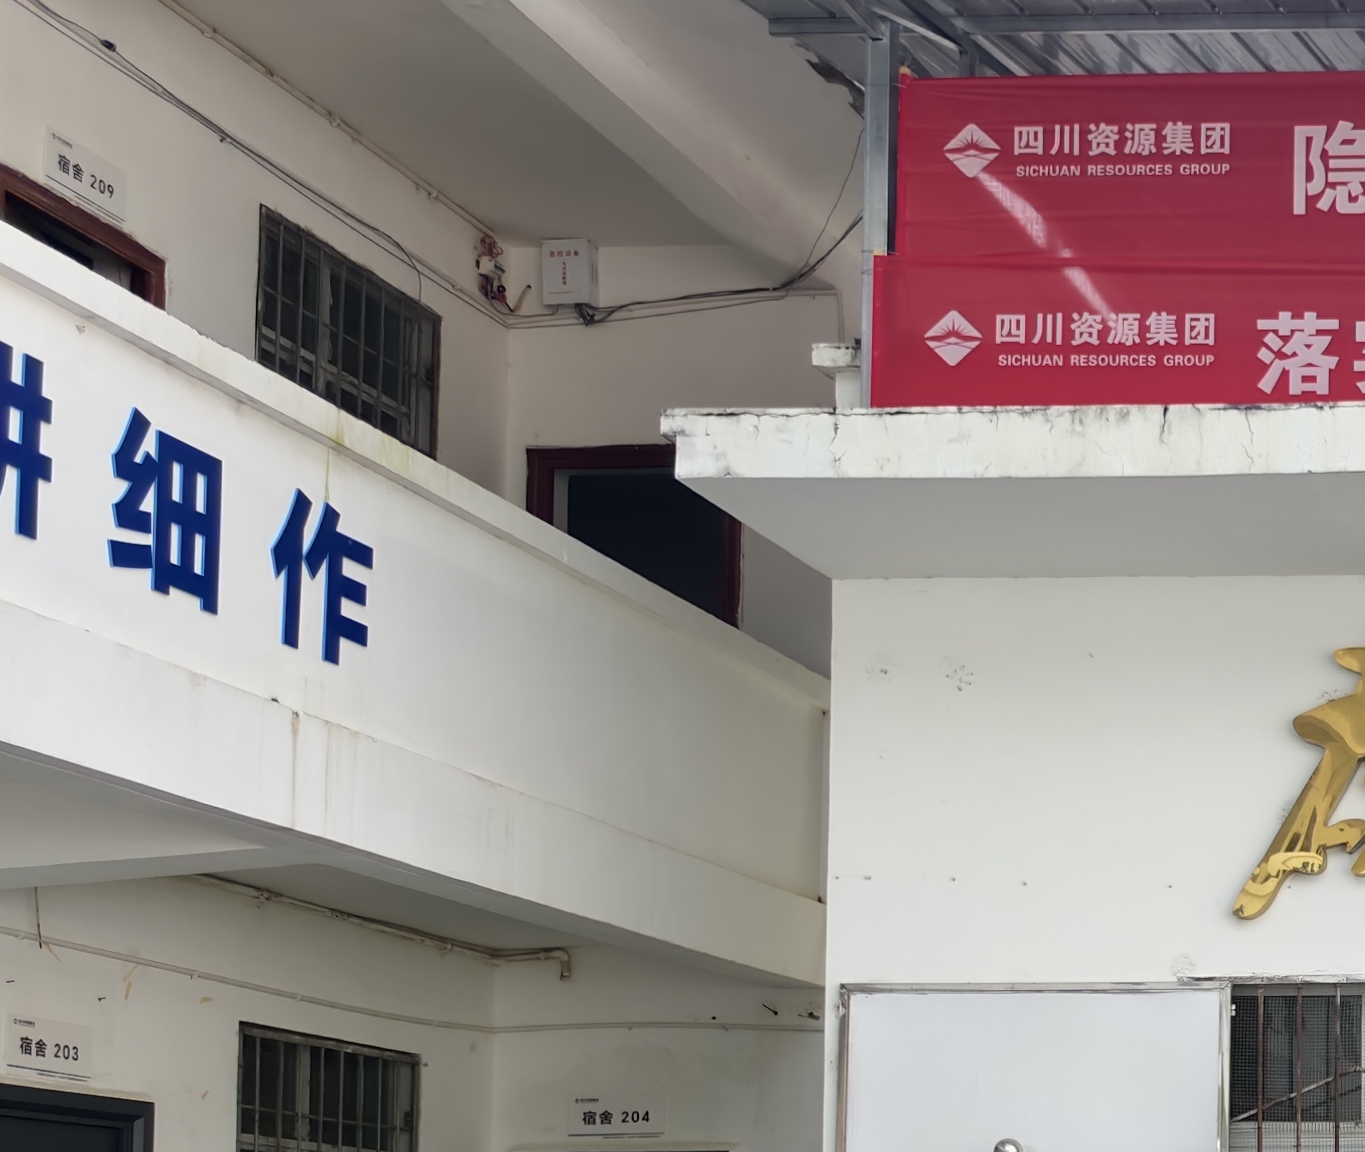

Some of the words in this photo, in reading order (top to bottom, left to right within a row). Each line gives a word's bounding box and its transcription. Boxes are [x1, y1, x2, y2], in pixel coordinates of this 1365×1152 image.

[1014, 123, 1231, 157] 四川资源集团
[58, 153, 85, 183] 宿舍
[90, 174, 115, 198] 209
[1016, 163, 1080, 178] SICHUAN
[1086, 163, 1171, 178] RESOURCES
[1177, 162, 1231, 177] GROUP
[994, 312, 1216, 347] 四川资源集团
[998, 354, 1064, 369] SICHUAN
[1070, 354, 1157, 369] RESOURCES
[1162, 354, 1215, 368] GROUP
[20, 1036, 48, 1058] 宿舍
[54, 1043, 79, 1061] 203
[582, 1110, 614, 1126] 宿舍
[621, 1110, 650, 1123] 204
